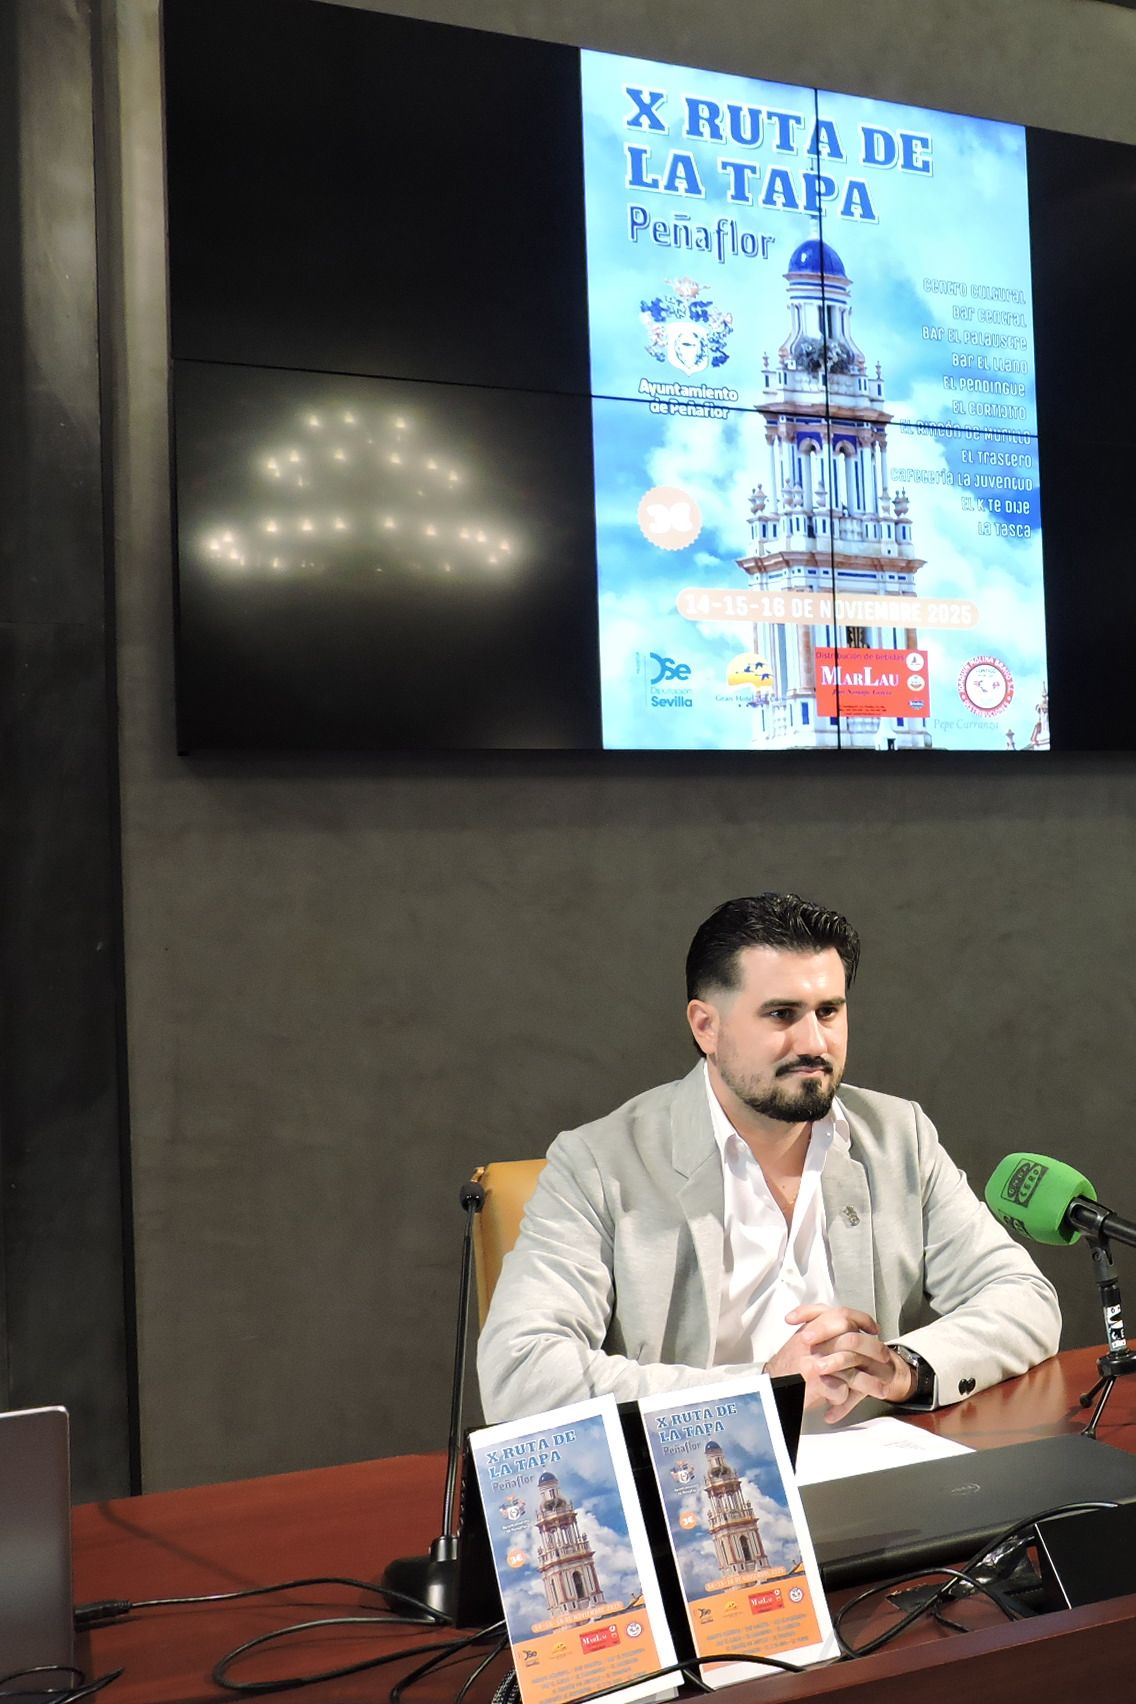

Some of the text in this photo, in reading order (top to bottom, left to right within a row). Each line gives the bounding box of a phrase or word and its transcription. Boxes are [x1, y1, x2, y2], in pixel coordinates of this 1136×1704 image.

[625, 87, 932, 173] X RUTA DE
[627, 145, 876, 221] LA TAPA
[629, 204, 775, 263] Peñaflor
[638, 378, 738, 402] Ayuntamiento
[649, 397, 730, 420] de Peñaflor
[792, 599, 815, 618] DE
[820, 600, 921, 622] NOVIEMBRE
[927, 603, 972, 624] 2025
[651, 696, 693, 708] Sevilla
[656, 1403, 737, 1428] X RUTA DE
[659, 1420, 724, 1443] LA TAPA
[487, 1430, 577, 1464] X RUTA DE
[489, 1450, 561, 1479] LA TAPA
